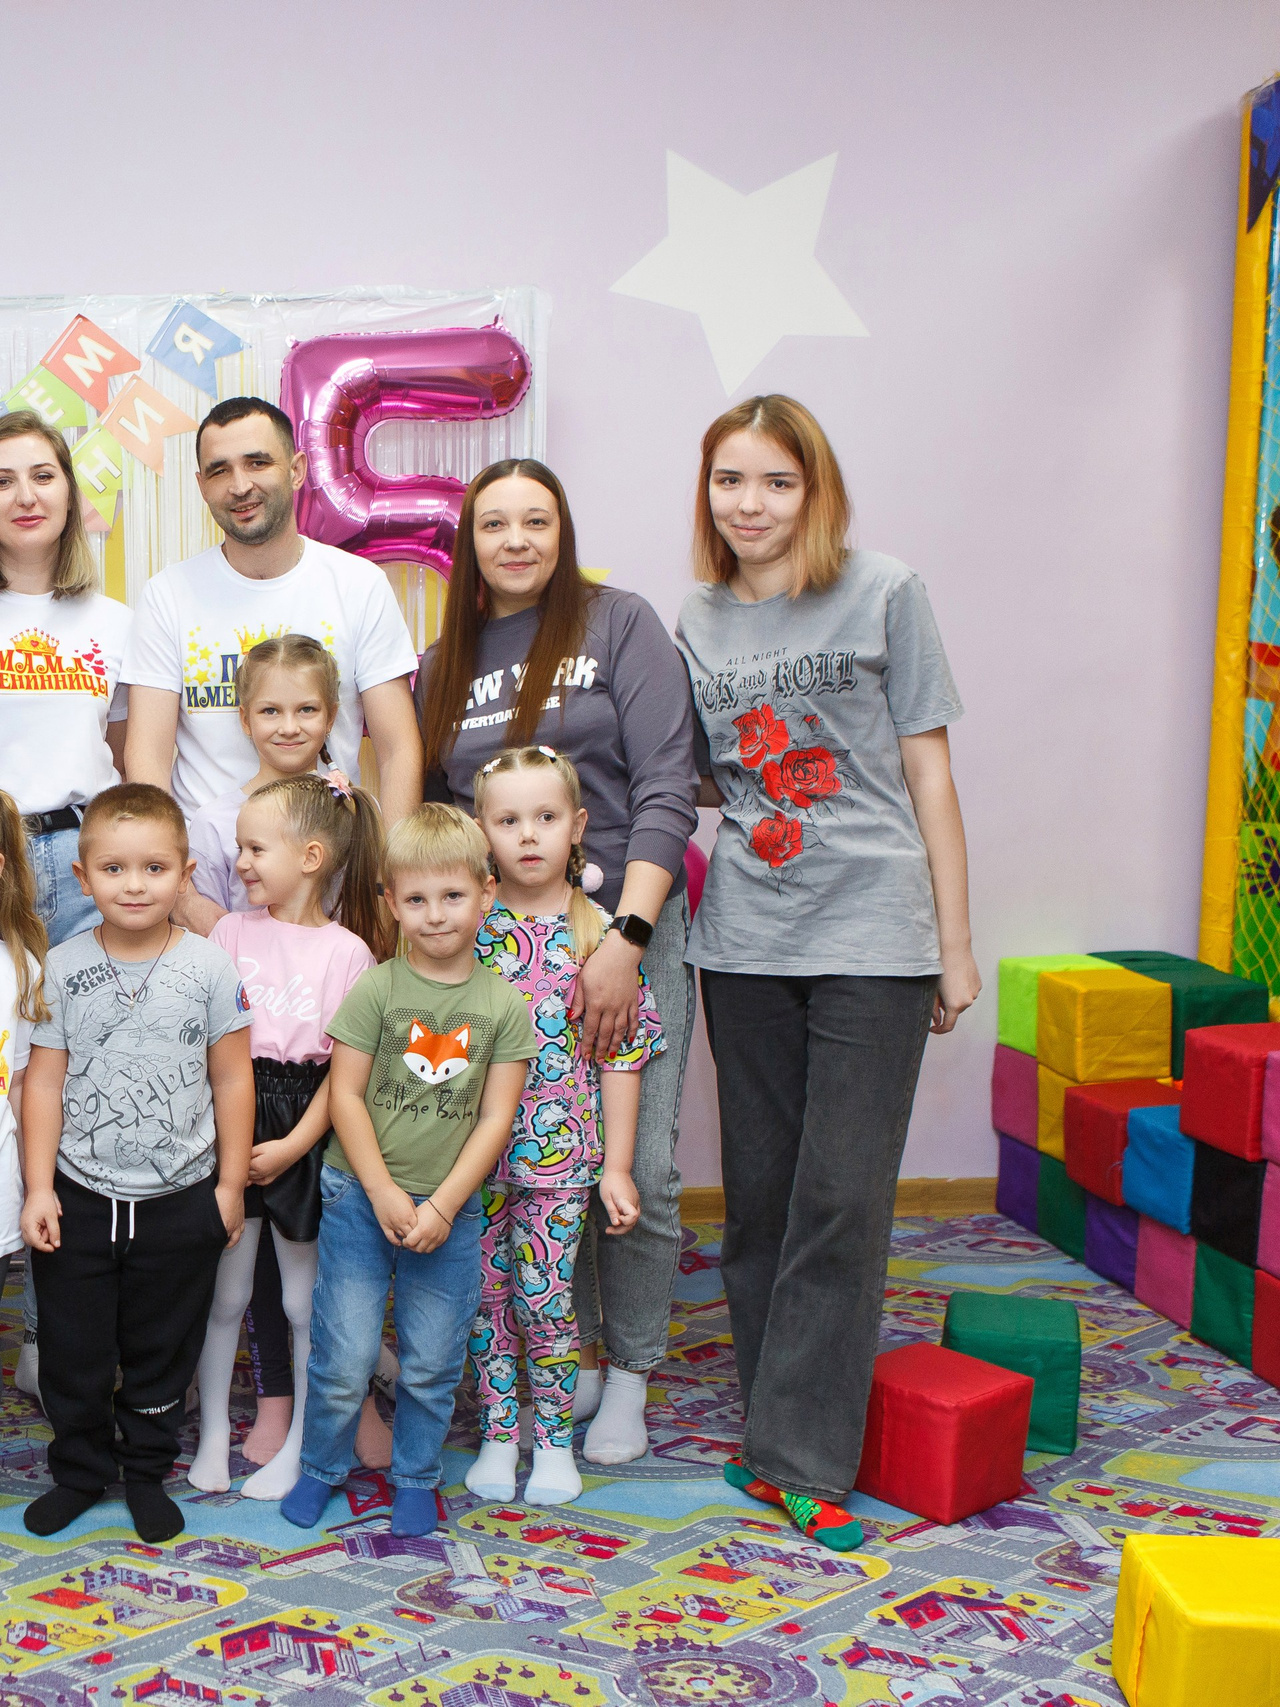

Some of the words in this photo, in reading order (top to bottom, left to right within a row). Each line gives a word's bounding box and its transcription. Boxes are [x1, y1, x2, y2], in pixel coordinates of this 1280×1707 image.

[510, 655, 599, 694] YRK
[726, 655, 747, 667] ALL
[751, 646, 788, 662] NIGHT
[737, 669, 767, 690] and
[771, 649, 858, 699] ROLL
[81, 967, 122, 994] SENSE
[373, 1082, 429, 1122] College
